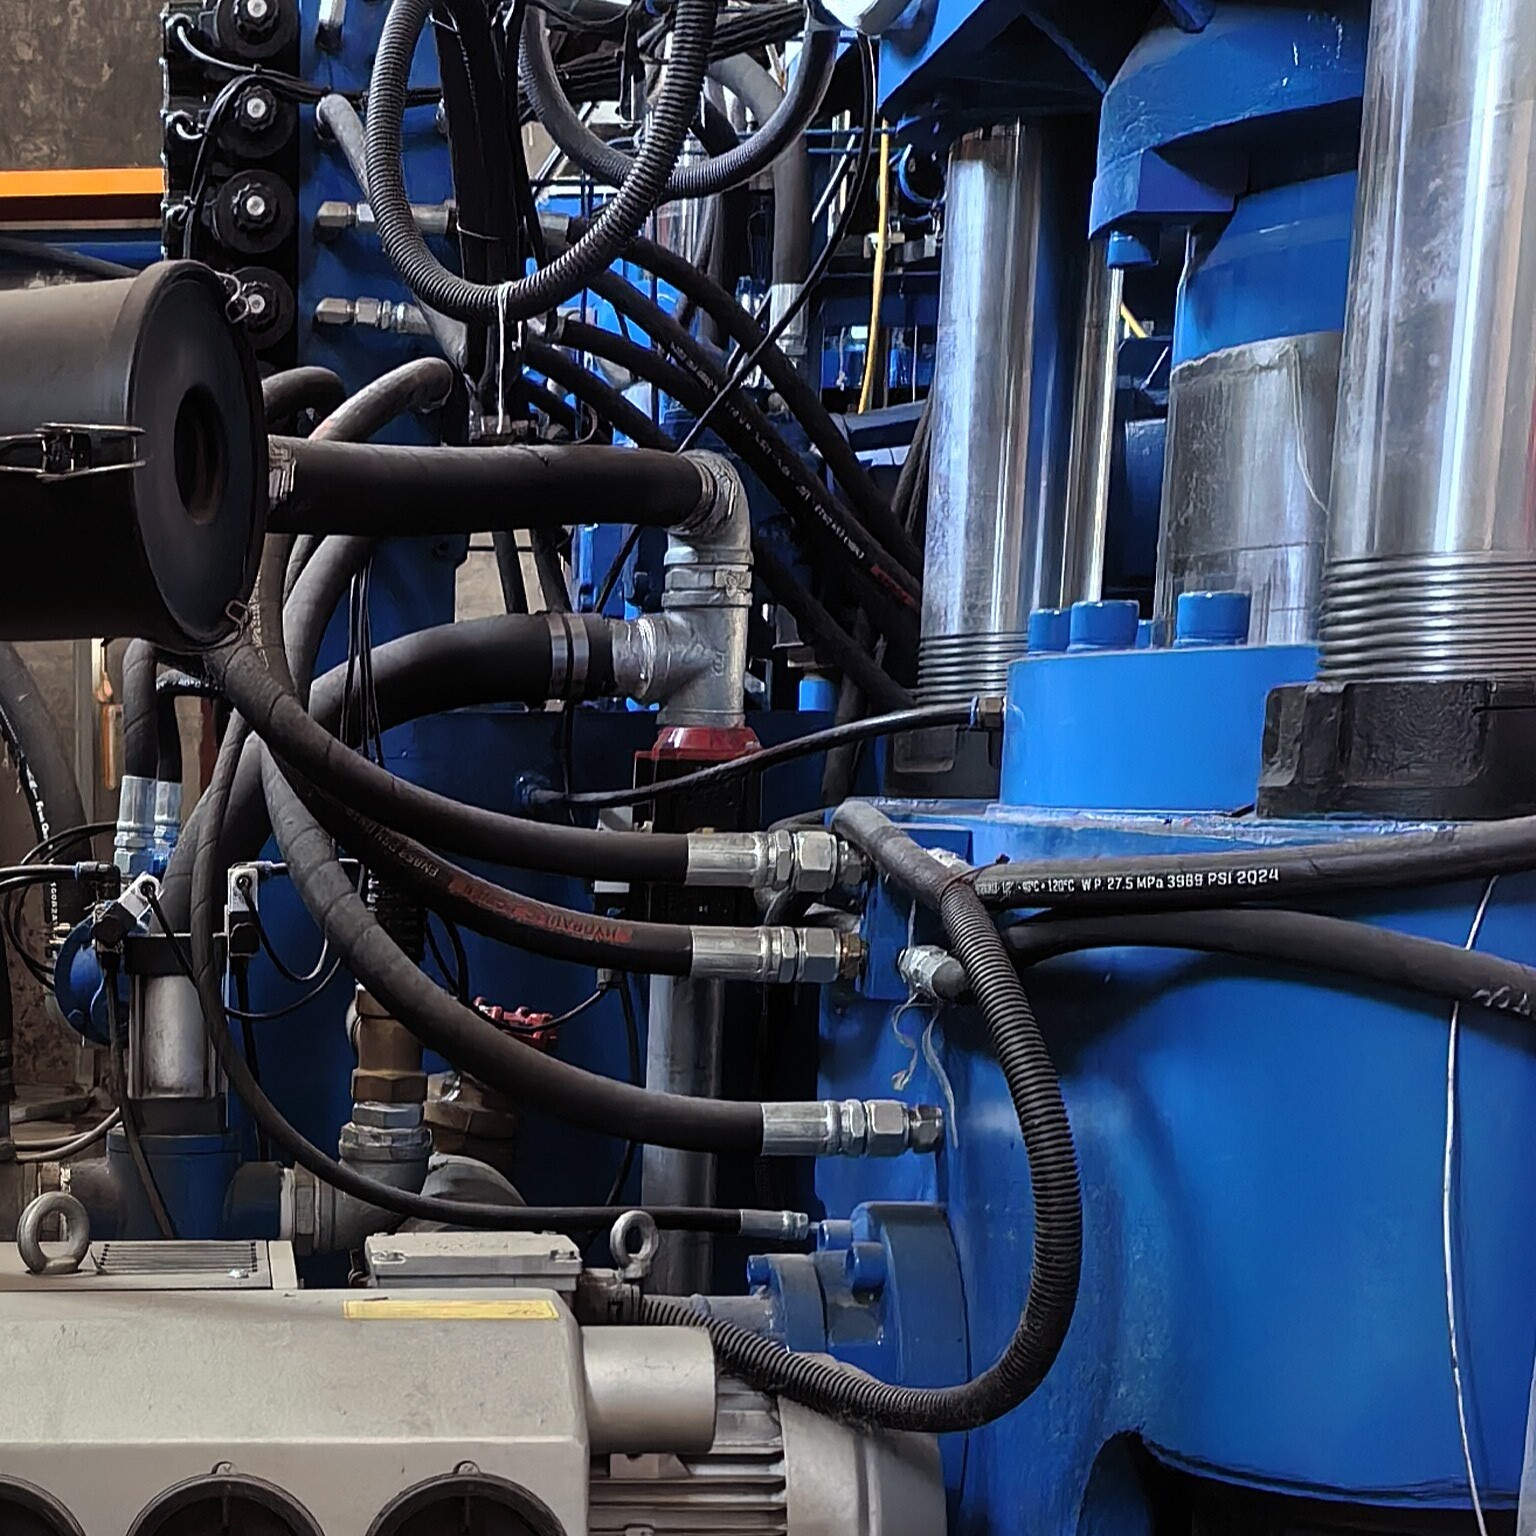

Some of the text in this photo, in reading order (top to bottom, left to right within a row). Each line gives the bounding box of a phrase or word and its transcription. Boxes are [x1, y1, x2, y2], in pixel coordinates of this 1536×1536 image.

[1107, 877, 1133, 890] 27.5
[1137, 876, 1164, 889] MPa
[1208, 871, 1232, 886] PSI
